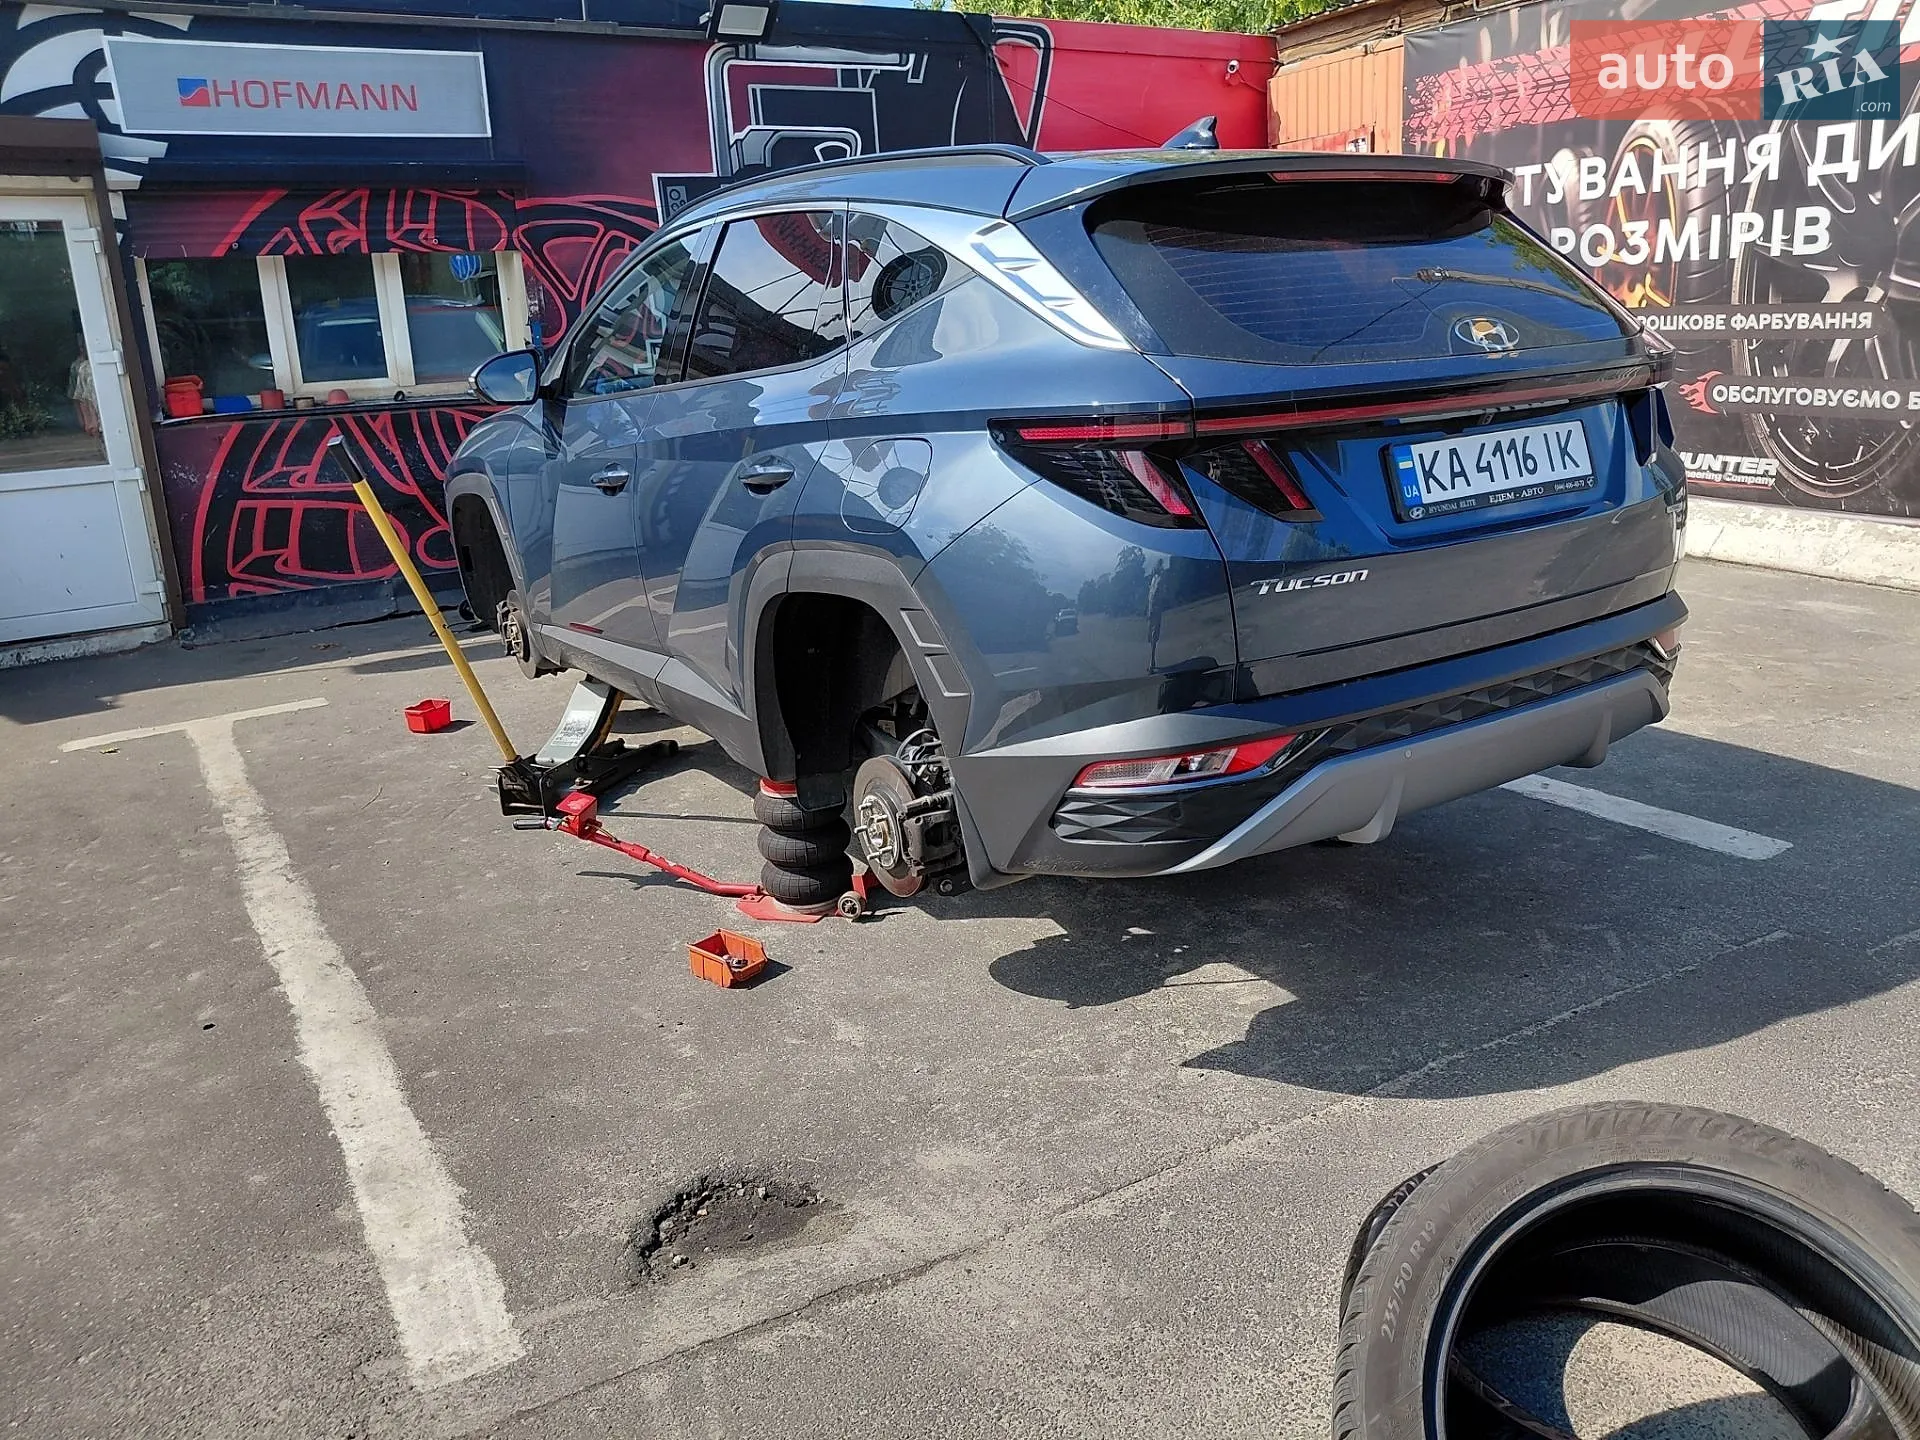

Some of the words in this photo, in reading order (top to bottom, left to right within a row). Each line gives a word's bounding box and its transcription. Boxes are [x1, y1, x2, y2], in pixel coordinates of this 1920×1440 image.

[212, 79, 418, 111] HOFMANN
[1508, 132, 1783, 207] ТУВАННЯ
[1551, 206, 1832, 268] РОЗМІРІВ
[1730, 311, 1873, 331] ФАРБУВАННЯ
[1712, 384, 1901, 409] ОБСЛУГОВУЄМО
[1417, 447, 1473, 495] KA
[1475, 435, 1538, 483] 4116
[1543, 429, 1581, 472] IK
[1403, 485, 1421, 499] UA
[1381, 1262, 1413, 1343] 235/50
